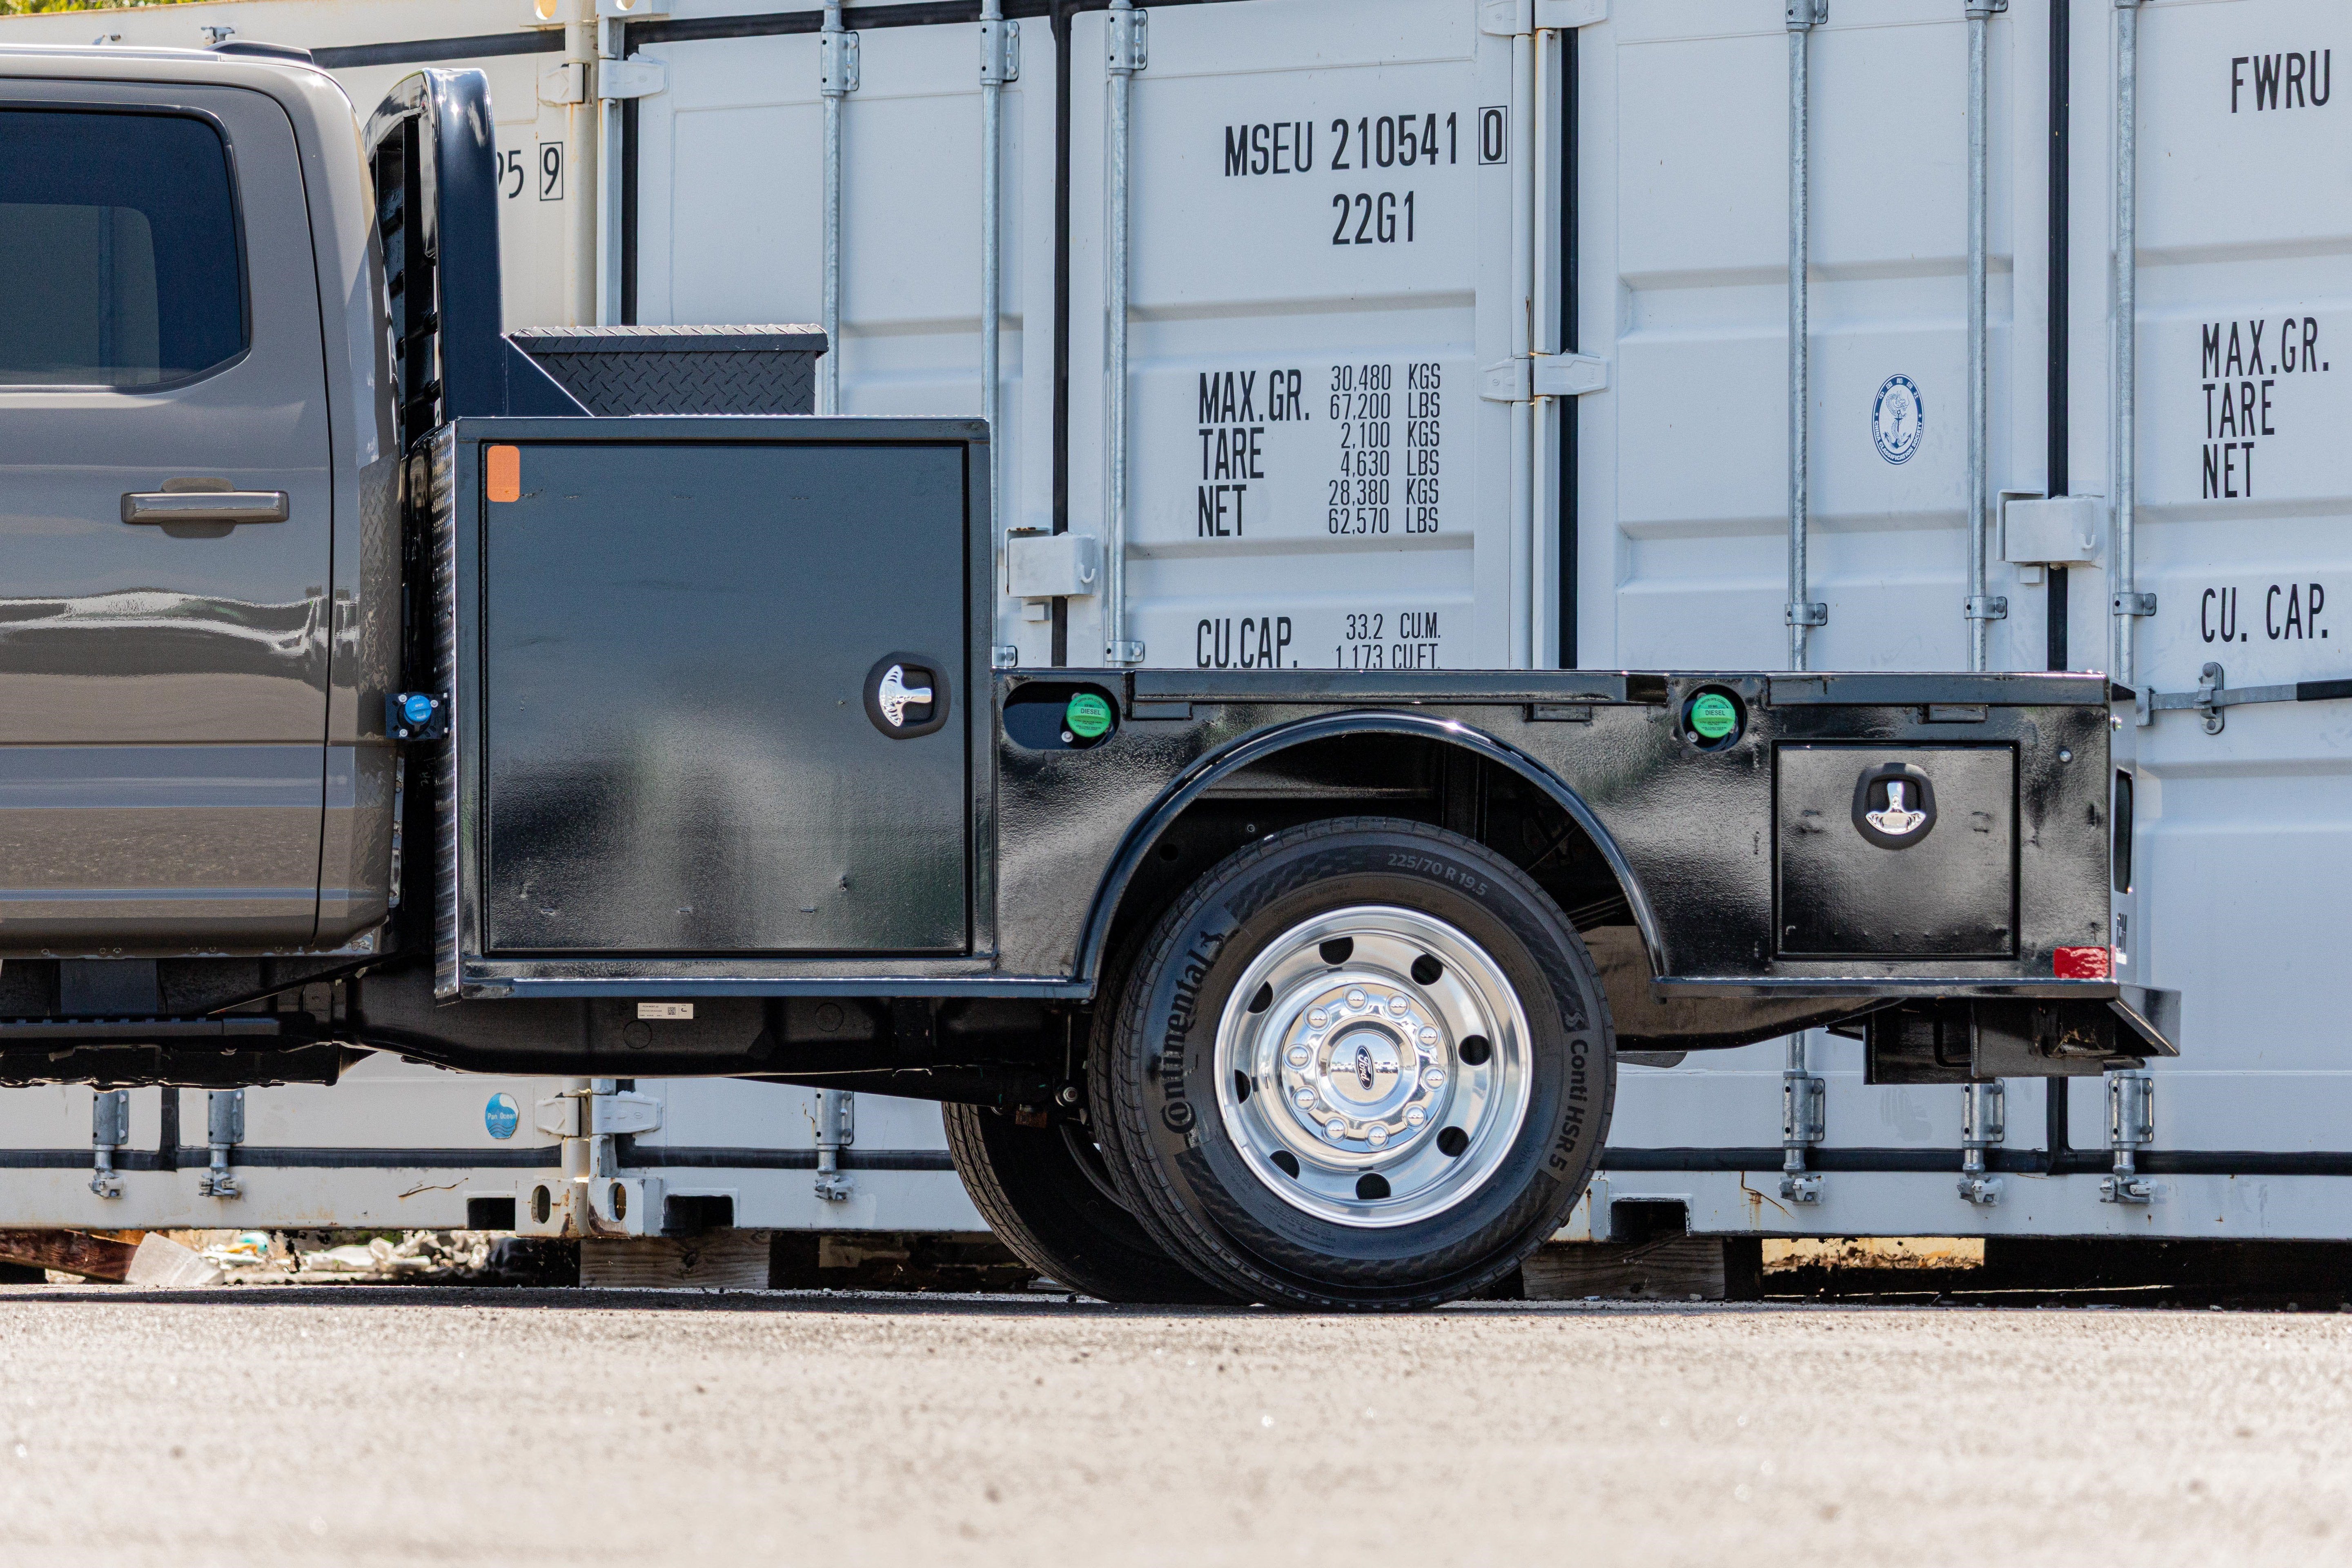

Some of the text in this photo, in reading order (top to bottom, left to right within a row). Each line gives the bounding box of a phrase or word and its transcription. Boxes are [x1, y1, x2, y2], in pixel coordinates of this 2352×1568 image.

[2232, 49, 2330, 113] FWRU
[1225, 109, 1502, 176] MSEU 210541 0
[543, 147, 559, 195] 9
[1332, 191, 1414, 245] 22G1
[2203, 317, 2329, 379] MAX.GR.
[1199, 369, 1309, 424] MAX.GR.
[1331, 363, 1441, 392] 30,480 KGS
[1330, 392, 1440, 420] 67,200 LBS
[2203, 380, 2274, 439] TARE
[1199, 427, 1264, 480] TARE
[1341, 420, 1440, 449] 2,100 KGS
[1879, 441, 1913, 461] CLASSIFICATION
[1911, 421, 1922, 448] SOCIETY
[1341, 449, 1439, 477] 4,630 LBS
[2203, 442, 2254, 499] NET
[1198, 484, 1247, 537] NET
[1329, 478, 1439, 506] 28,380 KGS
[1329, 507, 1438, 535] 62,570 LBS
[1346, 612, 1437, 640] 33.2 CU.M.
[2201, 583, 2328, 643] CU. CAP.
[1197, 617, 1297, 668] CU.CAP.
[1336, 644, 1383, 668] 1173
[1388, 853, 1488, 895] 225/70 R 19.5
[1161, 948, 1215, 1134] Continental
[1358, 1054, 1371, 1081] Ford
[1549, 1039, 1588, 1172] Conti HSR 5
